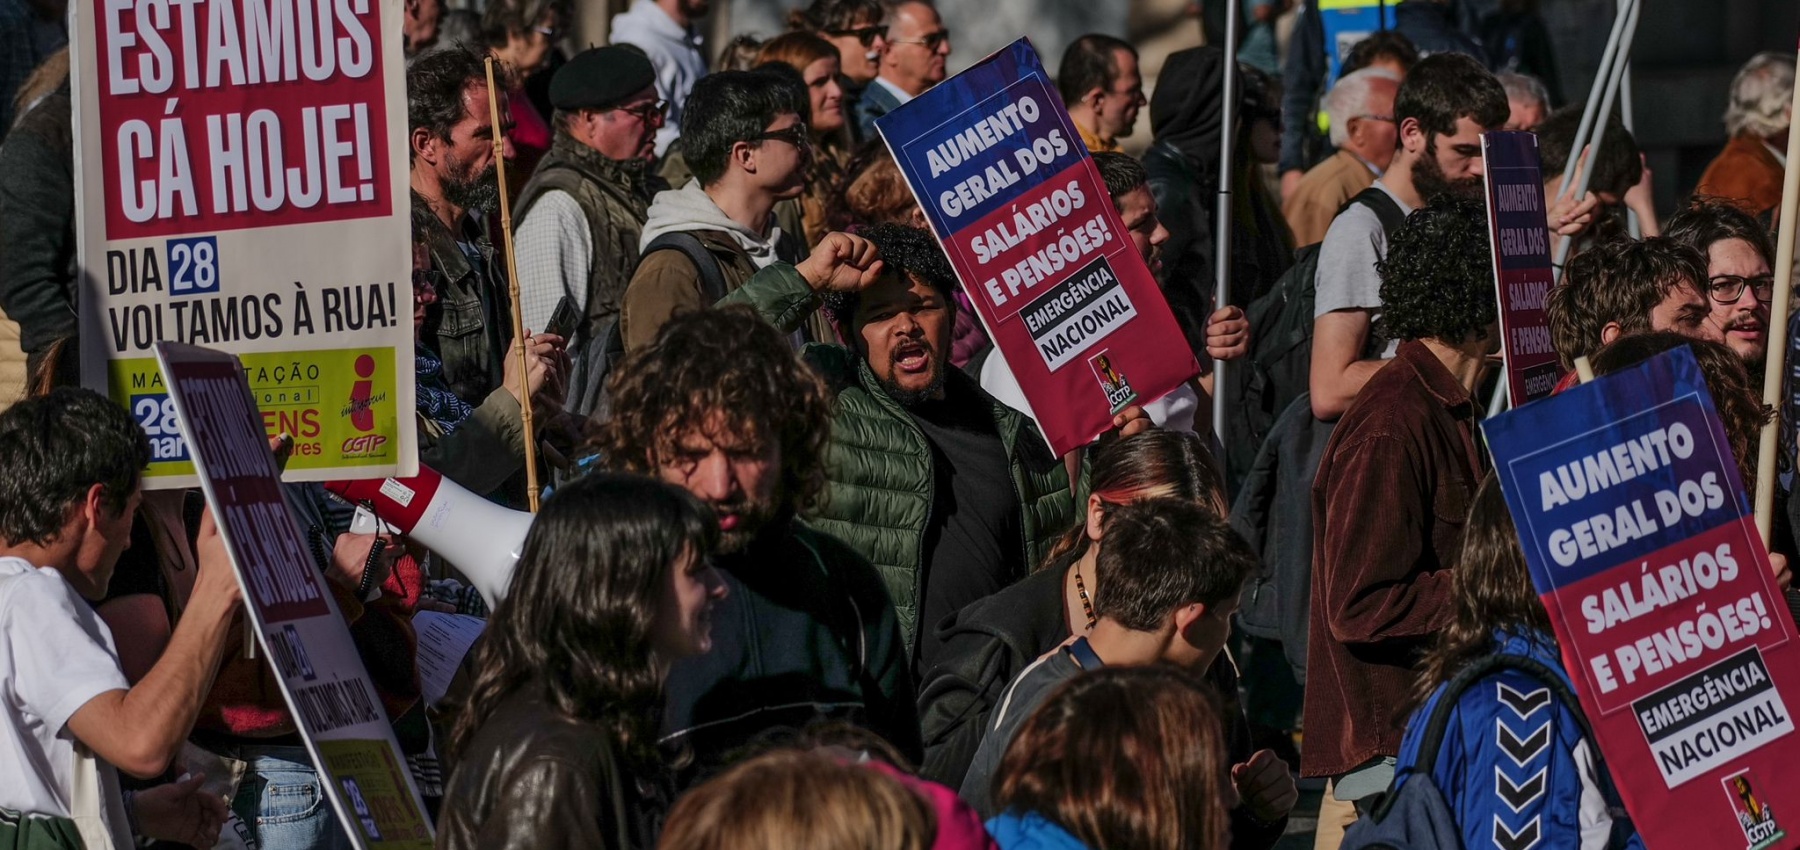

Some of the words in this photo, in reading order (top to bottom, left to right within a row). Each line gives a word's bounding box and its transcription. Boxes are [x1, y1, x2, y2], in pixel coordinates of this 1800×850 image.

[107, 0, 373, 95] ESTAMOS
[117, 98, 198, 223] CÁ
[206, 102, 375, 214] HOJE!
[926, 96, 1040, 179] AUMENTO
[939, 156, 1021, 218] GERAL
[1013, 128, 1069, 176] DOS
[970, 180, 1085, 264] SALÁRIOS
[1498, 184, 1538, 212] AUMENTO
[107, 247, 163, 295] DIA
[171, 241, 217, 291] 28
[984, 277, 1008, 307] E
[1001, 214, 1113, 297] PENSÕES!
[1500, 228, 1528, 256] GERAL
[1528, 227, 1546, 255] DOS
[109, 293, 283, 351] VOLTAMOS
[294, 282, 315, 336] À
[322, 282, 397, 339] RUA!
[1025, 266, 1113, 333] EMERGÊNCIA
[1040, 294, 1130, 362] NACIONAL
[132, 362, 319, 388] MATAÇÃO
[1511, 327, 1520, 356] E
[135, 398, 181, 435] 28
[179, 377, 270, 480] ESTAMOS
[254, 389, 311, 403] ional
[1109, 385, 1131, 405] CGTP
[342, 434, 387, 453] CGTP
[1539, 421, 1695, 512] AUMENTO
[225, 485, 281, 607] CÁ
[247, 501, 320, 603] HOJE!
[1548, 500, 1658, 567] GERAL
[1654, 471, 1724, 527] DOS
[1581, 543, 1739, 634] SALÁRIOS
[1590, 654, 1619, 694] E
[1614, 591, 1772, 684] PENSÕES!
[1640, 661, 1766, 734] EMERGÊNCIA
[1658, 700, 1785, 775] NACIONAL
[1747, 820, 1776, 843] CGTP
